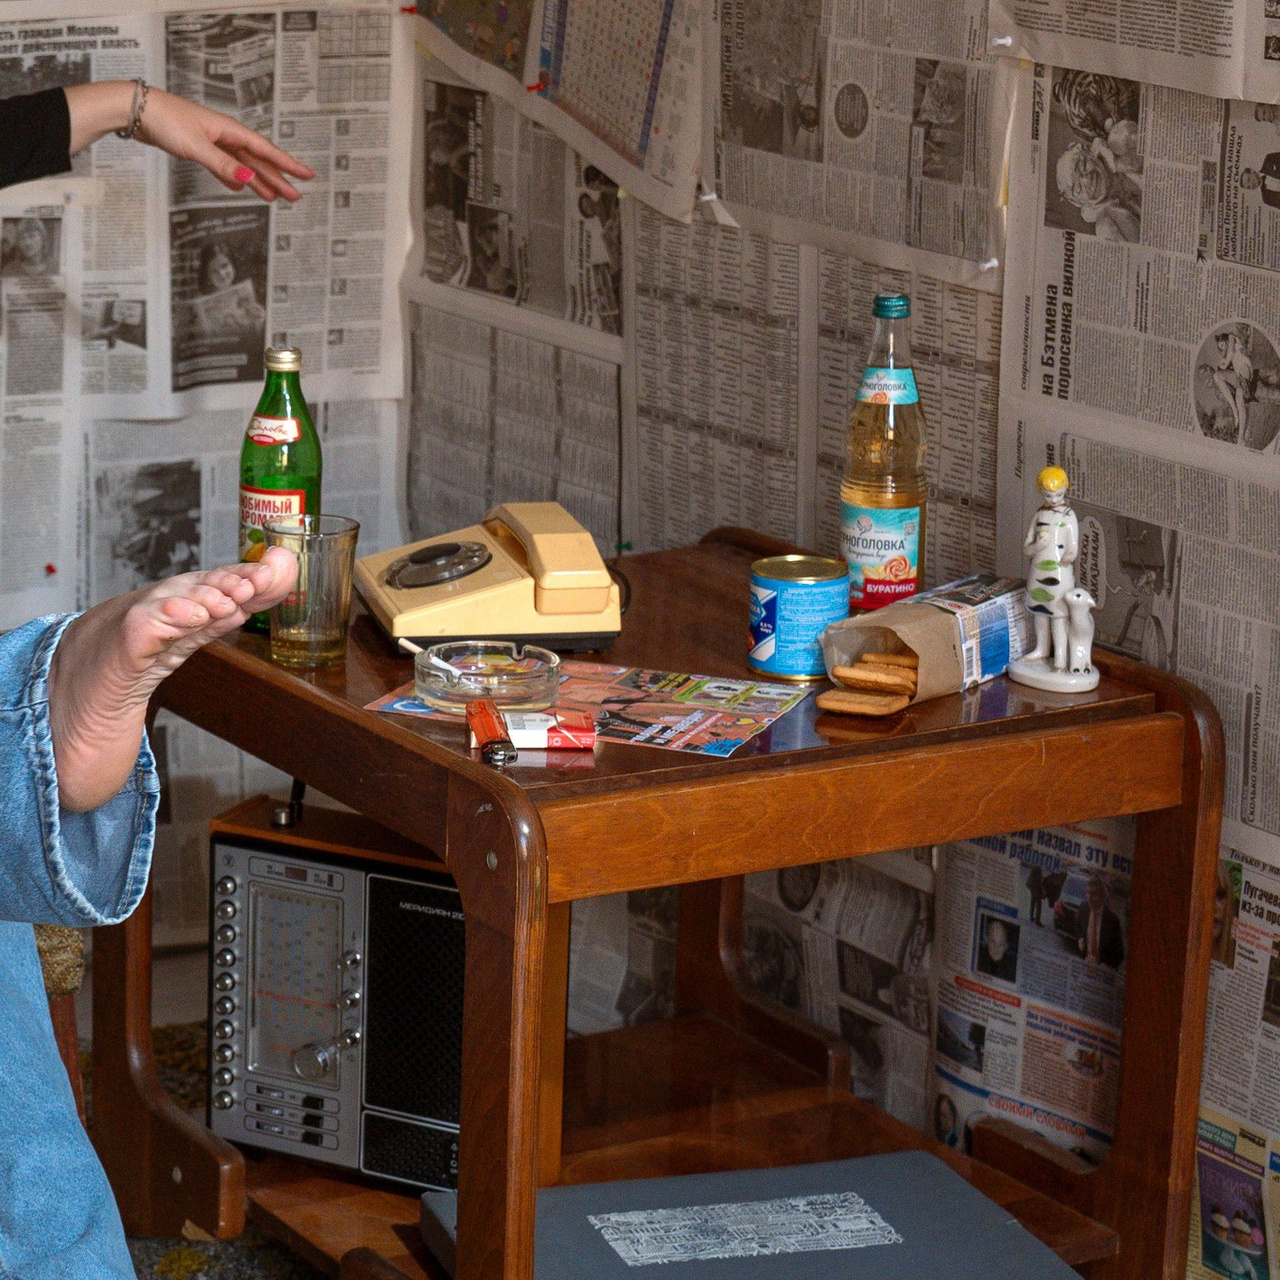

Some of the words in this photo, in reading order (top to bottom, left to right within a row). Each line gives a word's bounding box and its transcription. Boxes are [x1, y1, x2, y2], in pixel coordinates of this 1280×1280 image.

[17, 26, 64, 42] граждан
[66, 23, 119, 39] Молдовы
[22, 38, 98, 56] действующую
[100, 36, 141, 50] власть
[1057, 303, 1073, 401] поросенка
[1065, 230, 1077, 299] вилкой
[1042, 373, 1054, 397] на
[240, 495, 293, 515] ЮБИМЫЙ
[1078, 532, 1091, 587] ПИРОЖКИ
[866, 582, 916, 596] БУРАТИНО
[1252, 684, 1262, 748] получают?
[1248, 775, 1257, 823] Сколько
[1036, 829, 1081, 858] назвал
[1085, 845, 1108, 868] эту
[1229, 848, 1261, 868] Только
[399, 900, 452, 919] МЕРИДИАН
[1241, 899, 1264, 920] из-за
